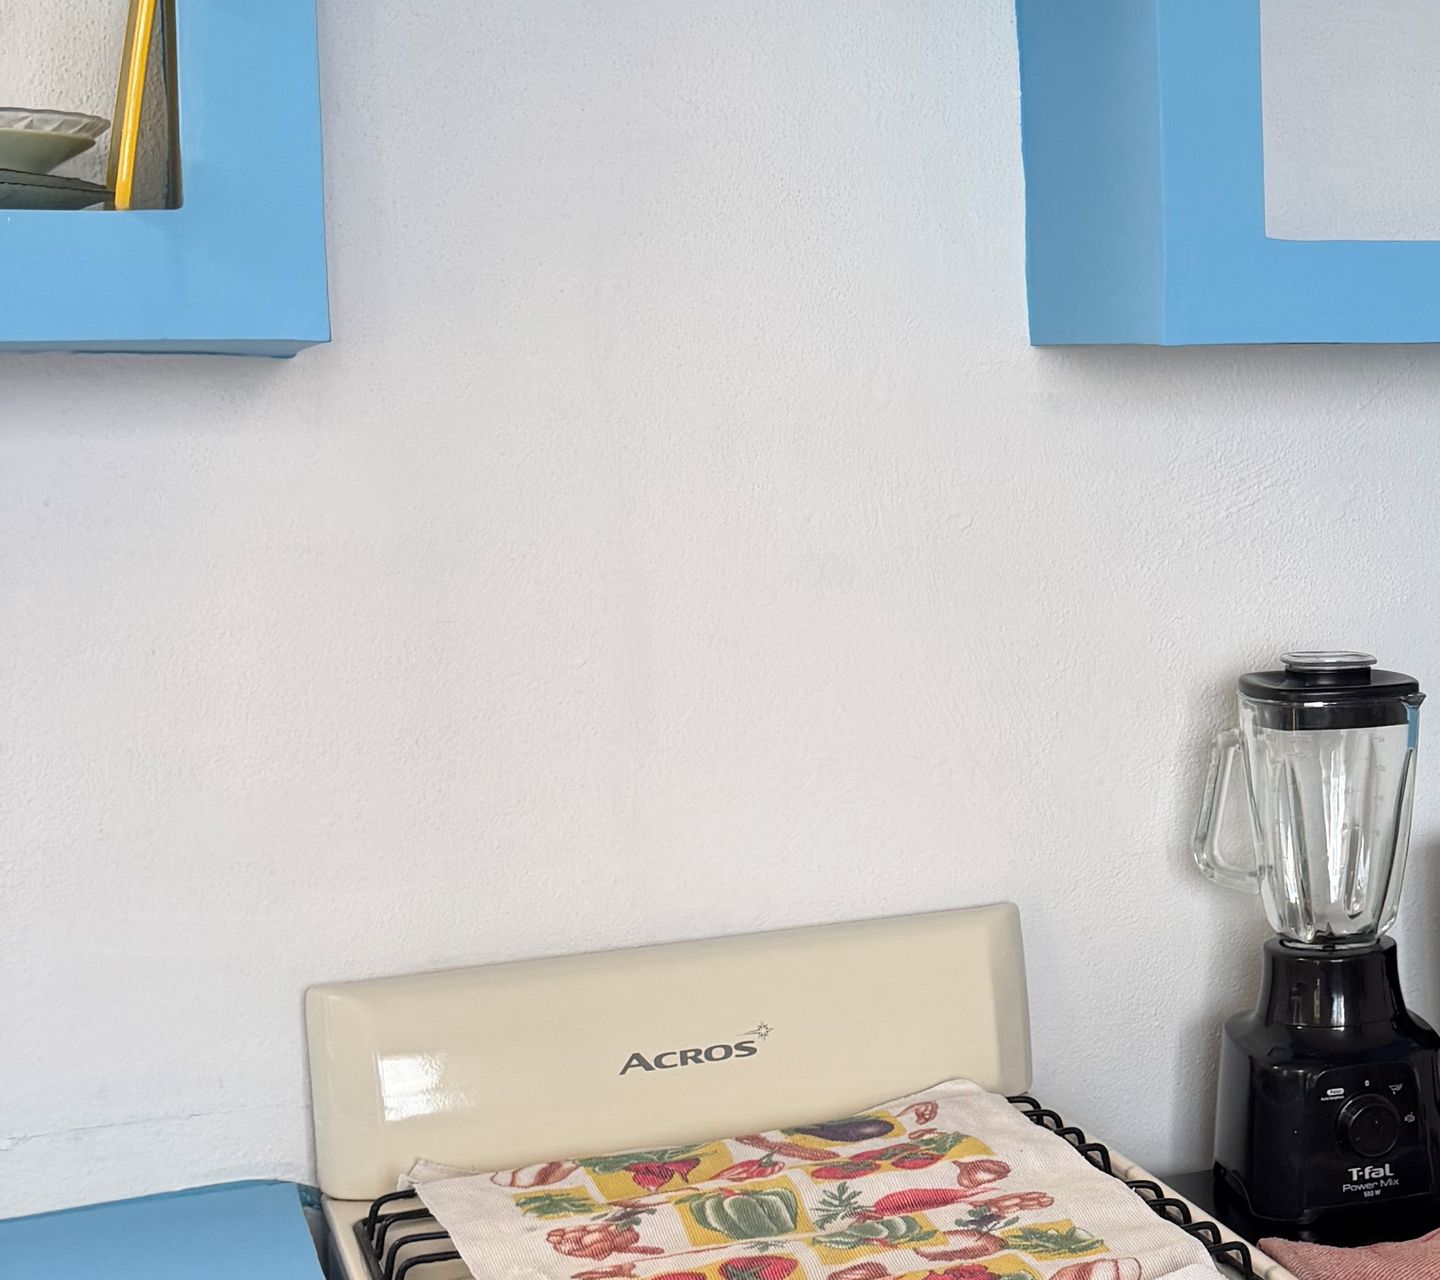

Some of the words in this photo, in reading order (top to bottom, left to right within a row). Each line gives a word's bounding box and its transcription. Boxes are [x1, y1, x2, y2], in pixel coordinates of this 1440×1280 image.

[618, 1040, 758, 1076] ACROS
[1342, 1182, 1379, 1193] Power
[1380, 1178, 1400, 1188] Mix
